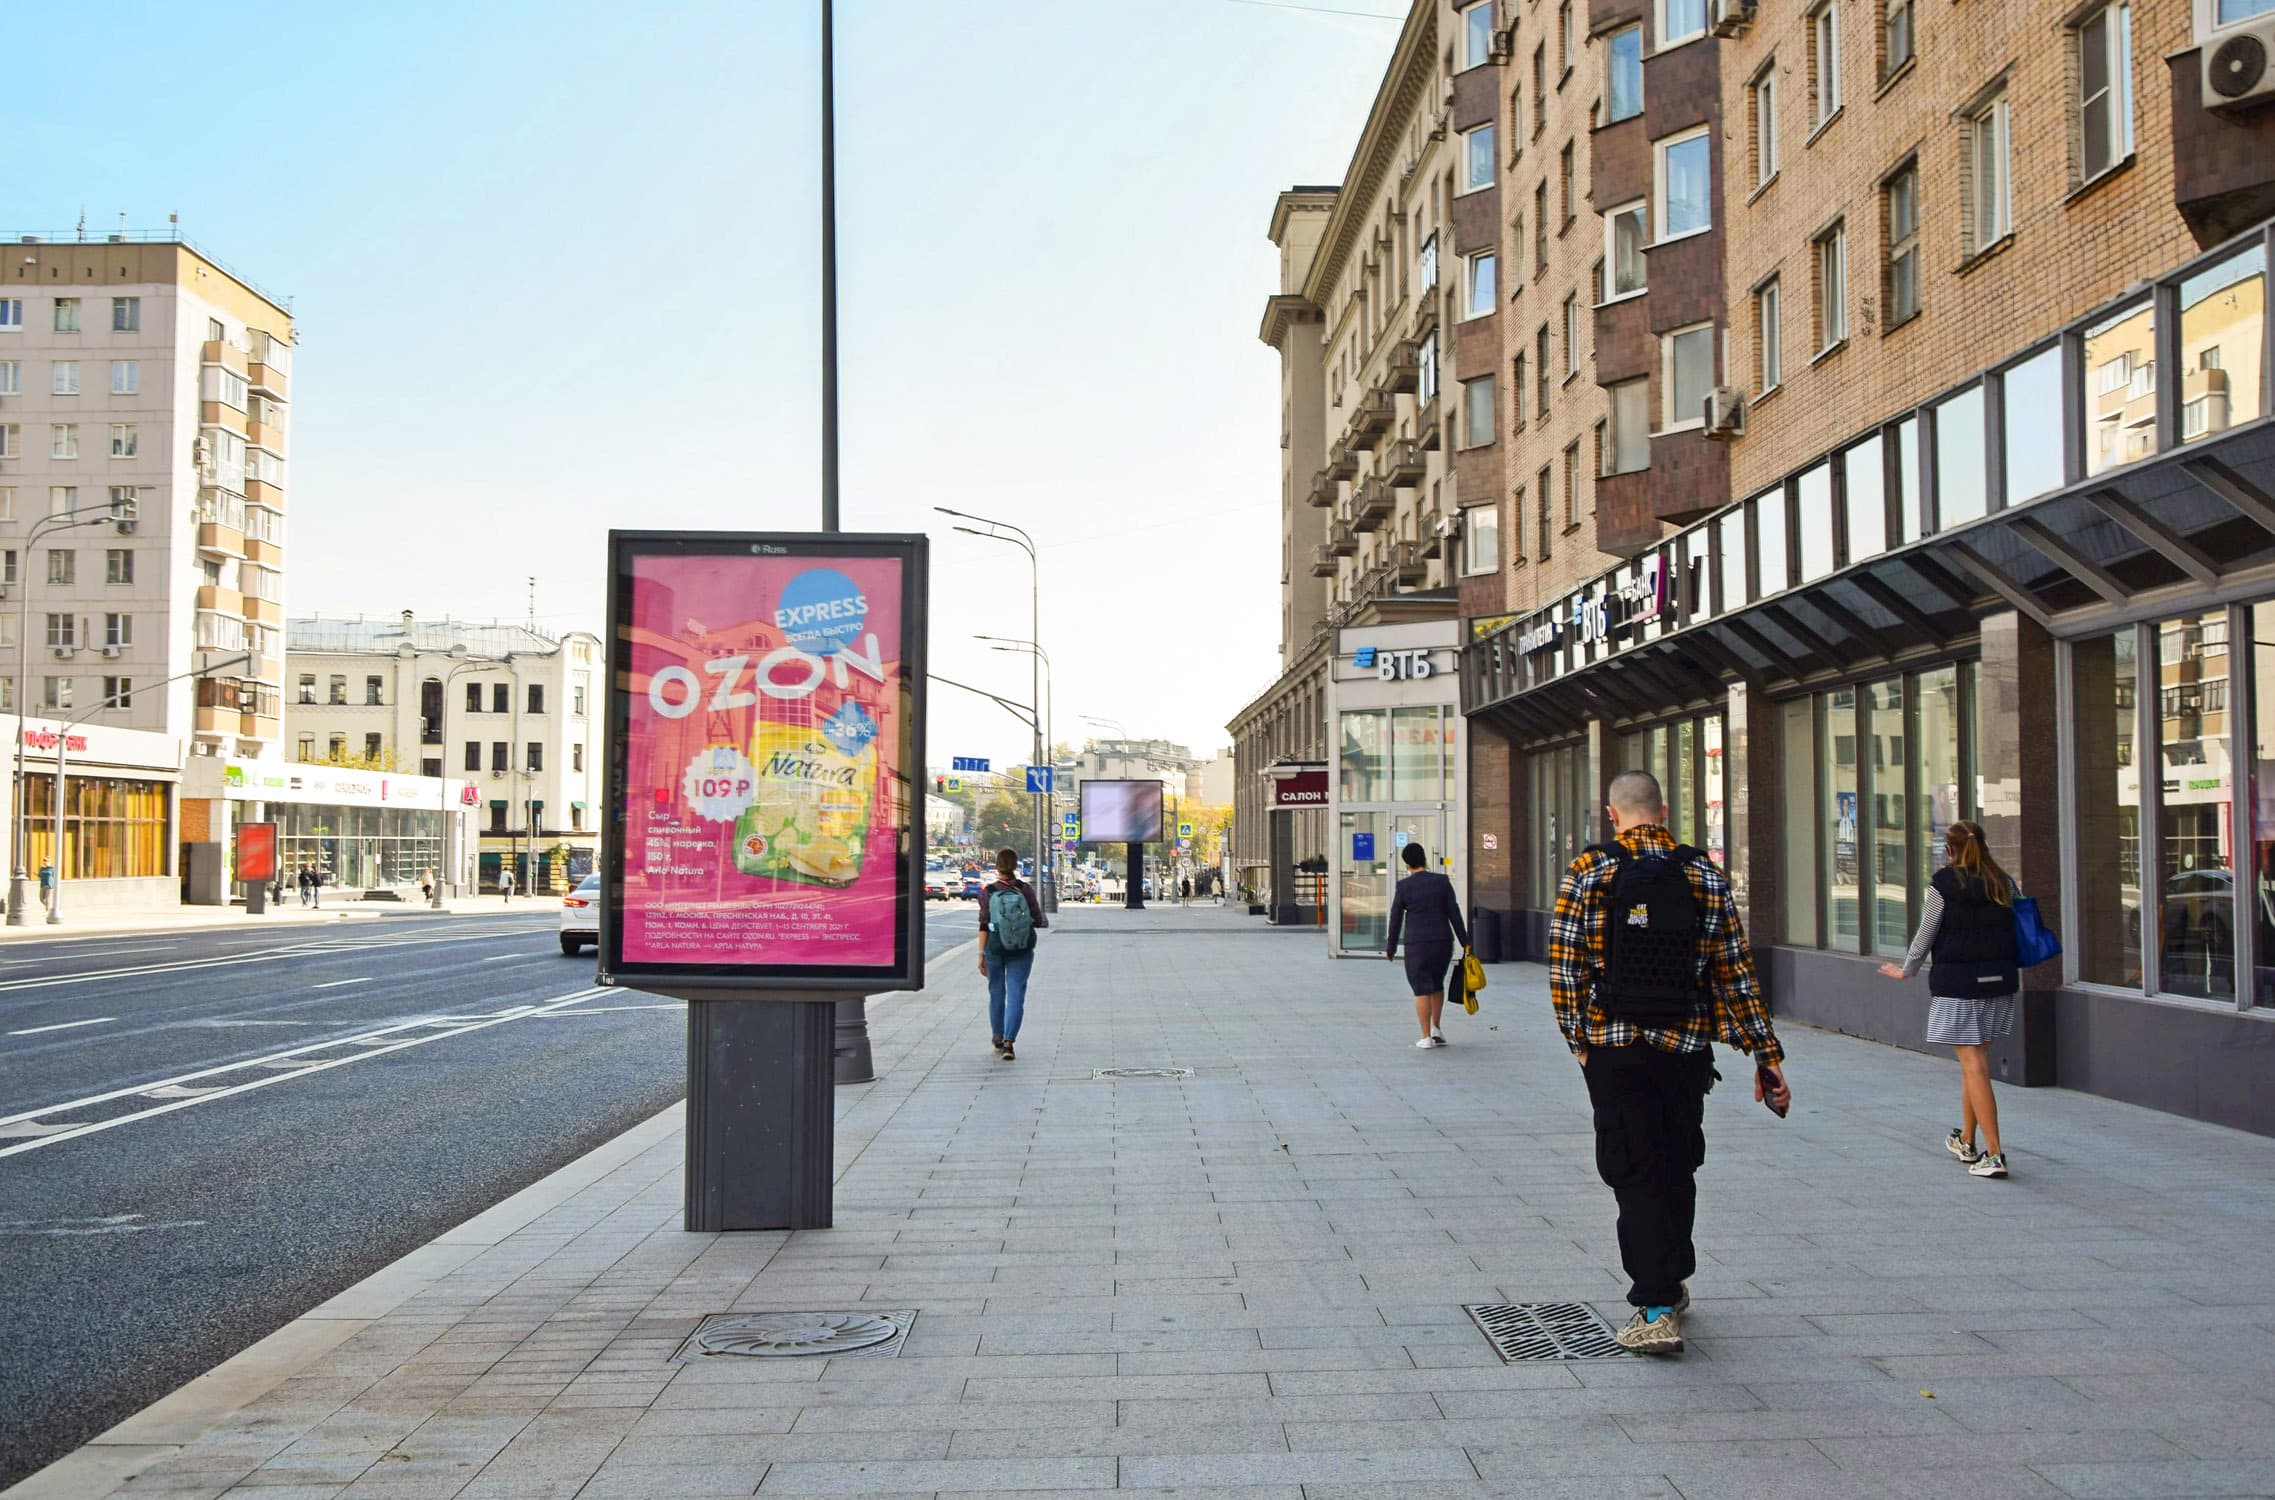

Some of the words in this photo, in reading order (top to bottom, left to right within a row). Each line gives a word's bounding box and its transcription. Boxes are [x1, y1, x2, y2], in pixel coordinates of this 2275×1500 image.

[762, 544, 787, 554] Russ
[1631, 572, 1653, 603] БАНК
[774, 595, 869, 628] EXPRESS
[1581, 595, 1607, 644] ВТБ
[785, 630, 821, 643] ВСЕГДА
[823, 623, 864, 637] БЫСТРО
[649, 632, 885, 719] OZON
[1378, 649, 1430, 681] ВТБ
[761, 751, 857, 785] Natura
[1281, 791, 1321, 801] САЛОН
[648, 811, 669, 821] Сыр
[647, 826, 701, 834] сливочный
[647, 865, 668, 874] Arla
[670, 865, 704, 875] Natura
